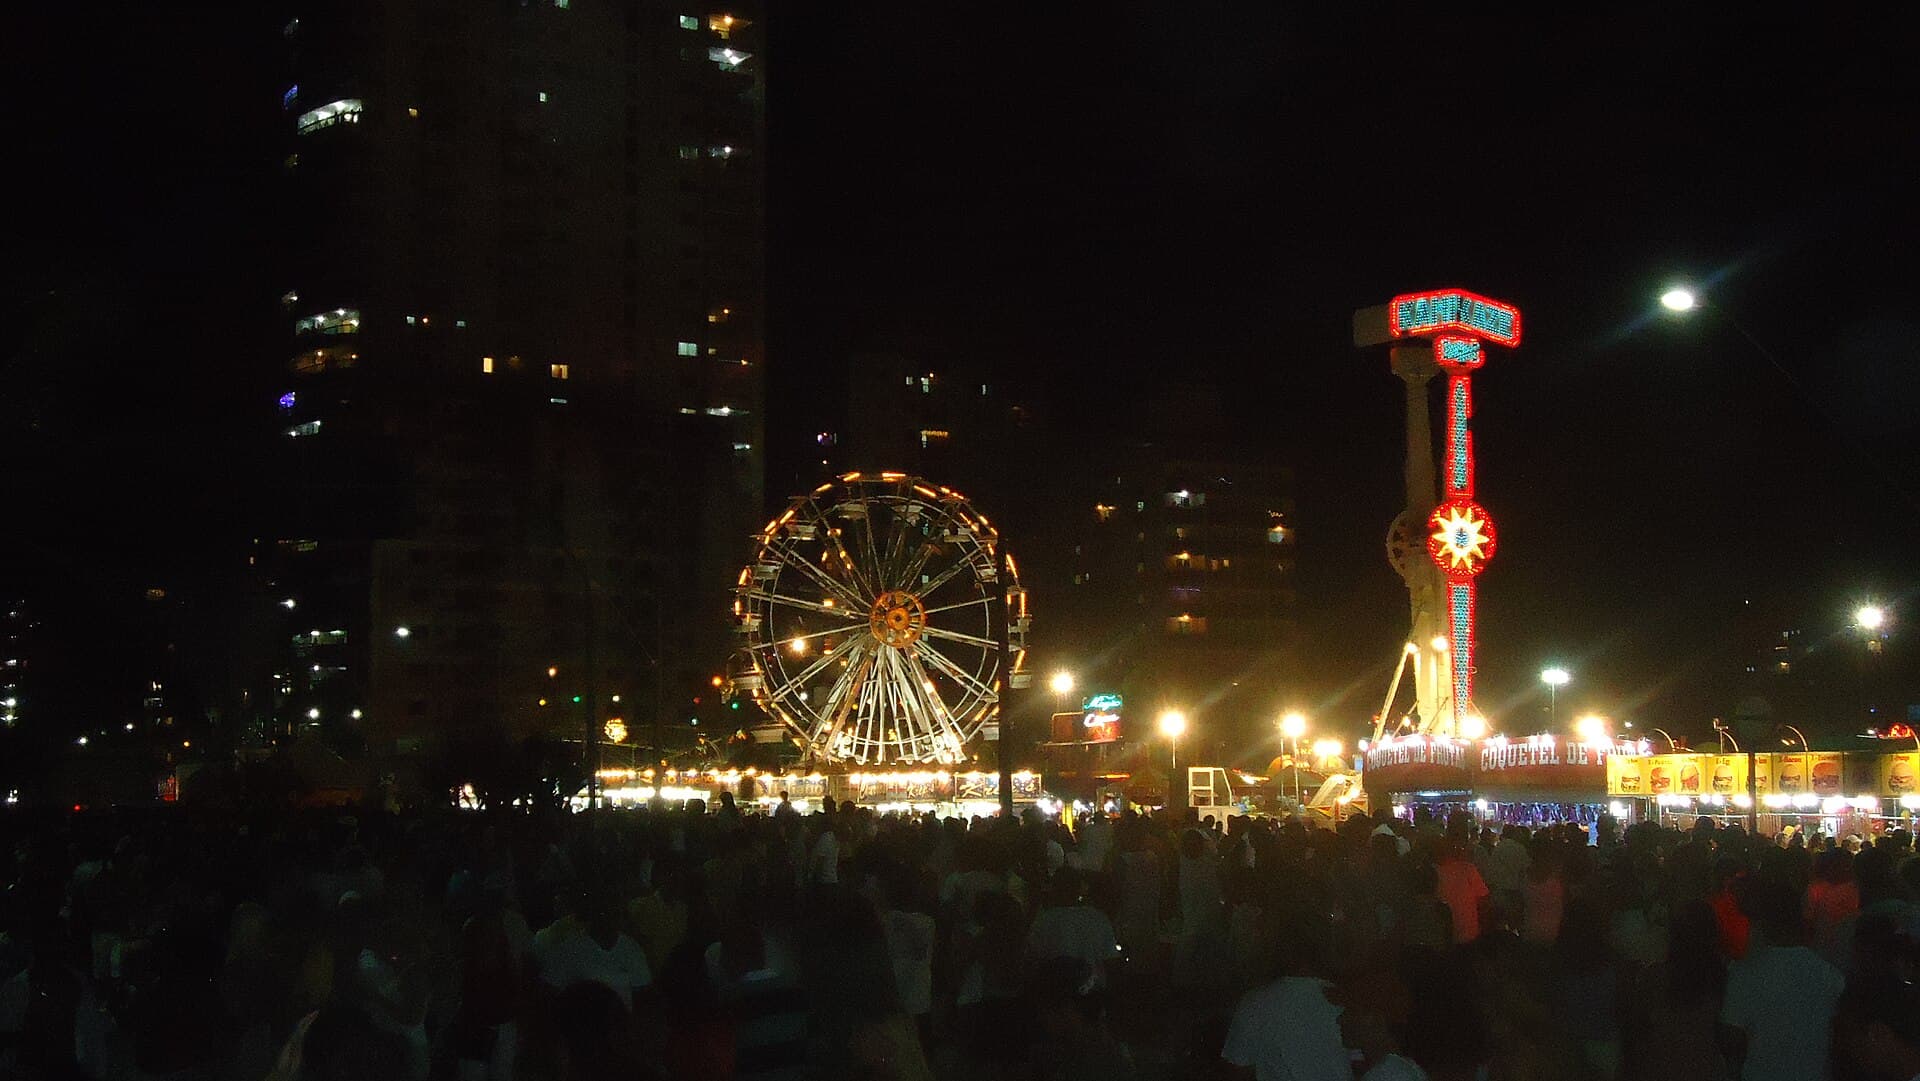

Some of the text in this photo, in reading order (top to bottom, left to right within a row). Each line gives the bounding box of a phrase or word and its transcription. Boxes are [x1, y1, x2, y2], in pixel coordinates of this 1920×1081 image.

[1367, 743, 1409, 771] COQUETEL
[1480, 742, 1559, 772] COQUETEL
[1567, 741, 1588, 766] DE
